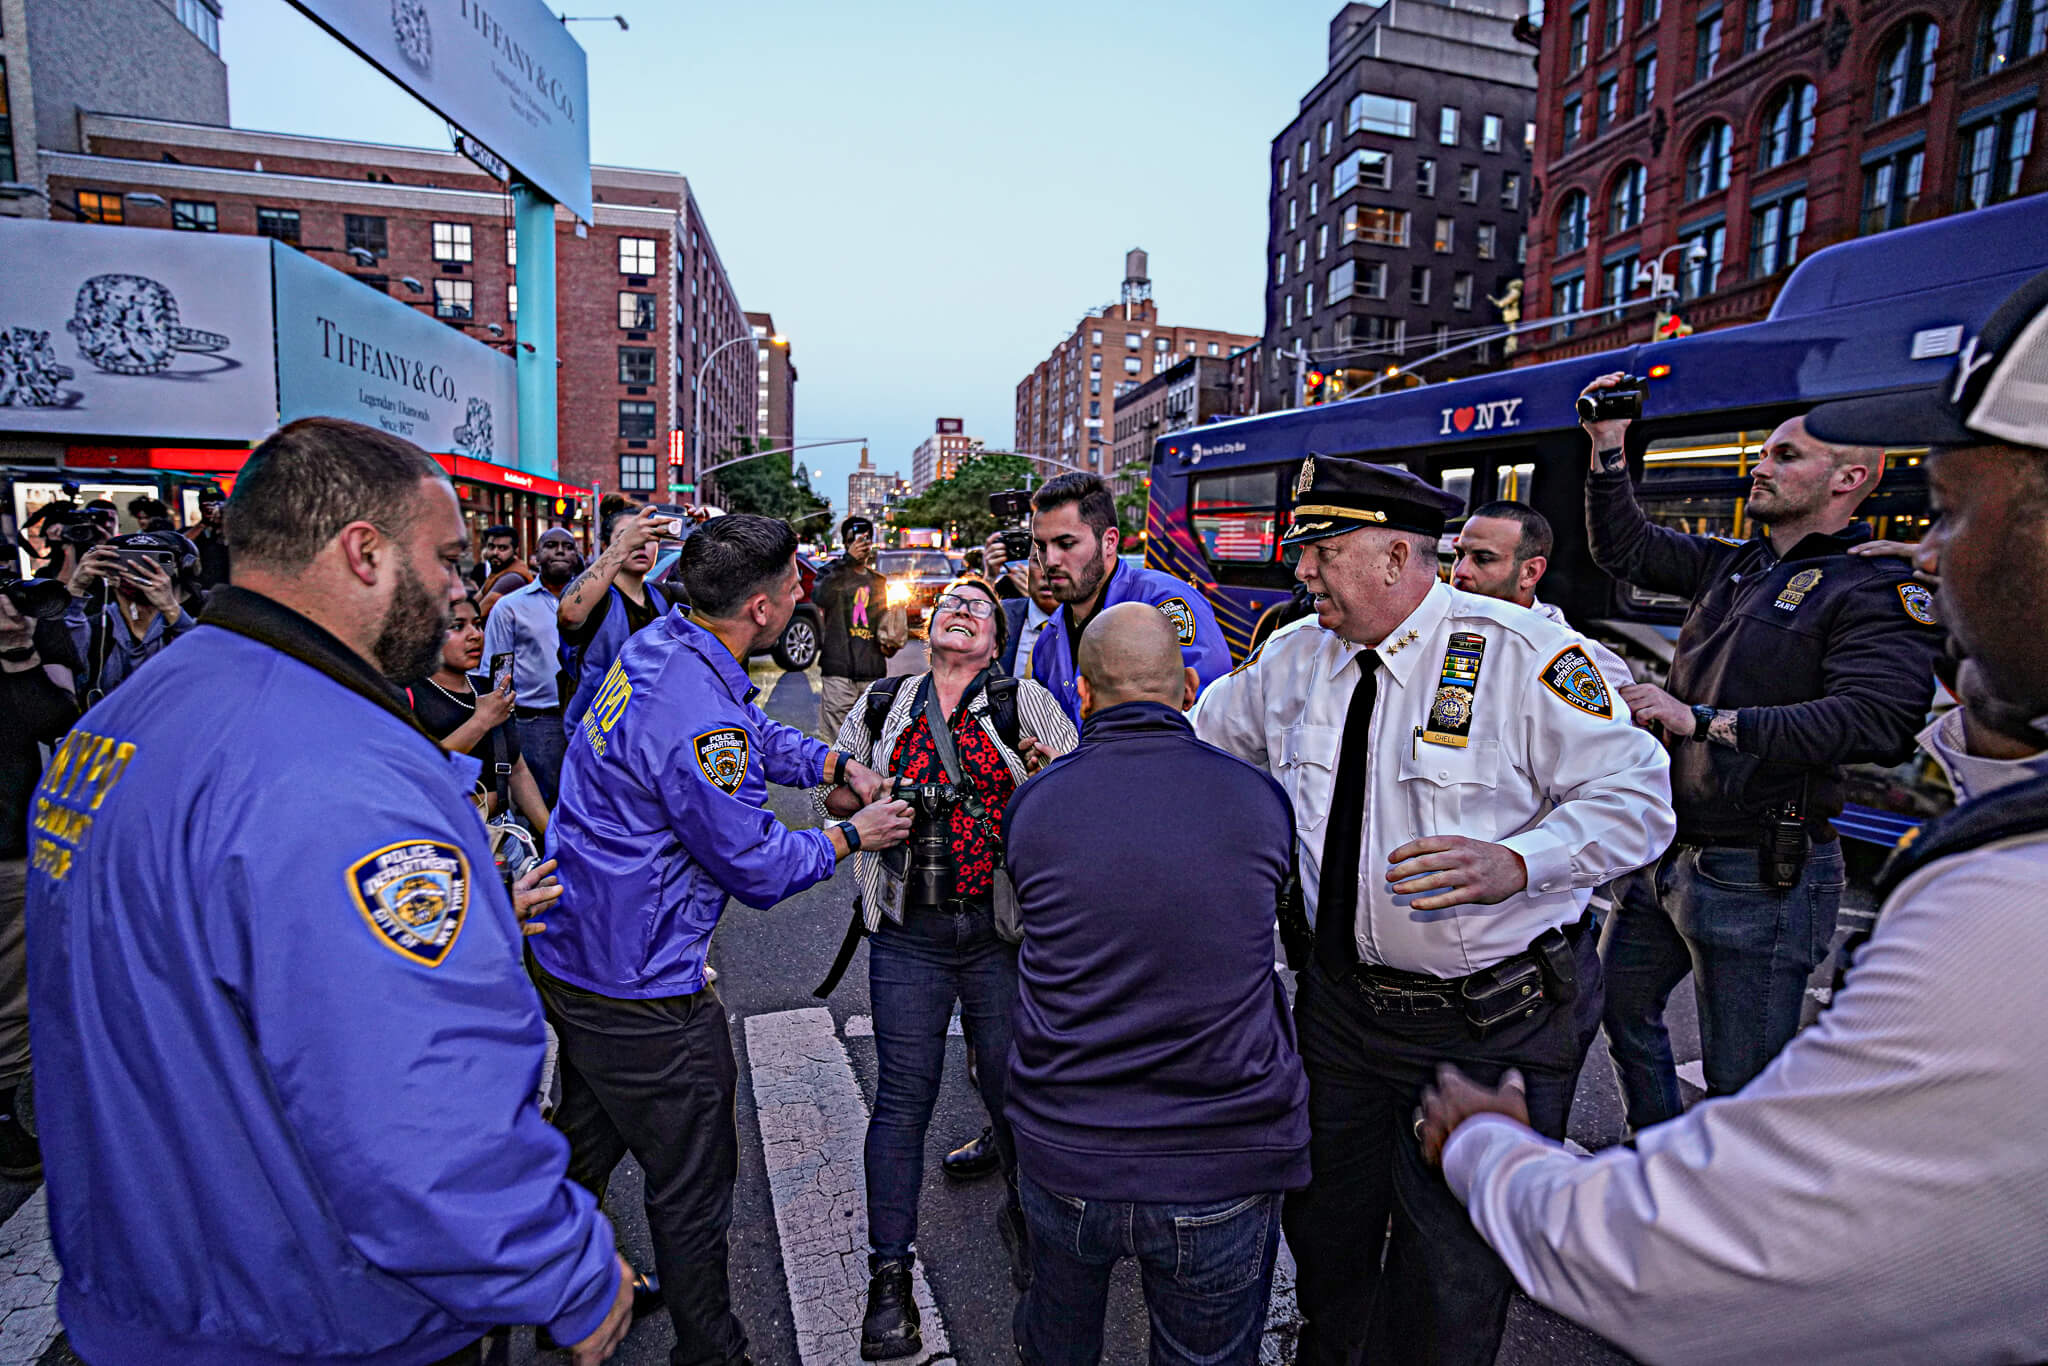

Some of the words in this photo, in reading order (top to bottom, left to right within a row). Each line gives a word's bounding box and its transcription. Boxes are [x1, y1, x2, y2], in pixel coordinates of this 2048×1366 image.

[1440, 408, 1454, 435] I
[1474, 398, 1522, 431] NY
[1553, 652, 1576, 673] POLICE
[1553, 656, 1588, 688] DEPARTMENT
[1567, 693, 1586, 707] CITY
[1588, 704, 1600, 712] OF
[701, 739, 744, 755] DEPARTMENT
[709, 732, 736, 744] POLICE
[703, 762, 716, 778] CITY
[714, 777, 724, 787] OF
[732, 771, 743, 787] NEW
[739, 751, 747, 771] YORK
[376, 844, 438, 870] POLICE
[362, 856, 458, 897] DEPARTMENT
[371, 906, 404, 937] CITY
[397, 933, 422, 949] OF
[433, 917, 459, 947] NEW
[447, 879, 465, 913] YORK
